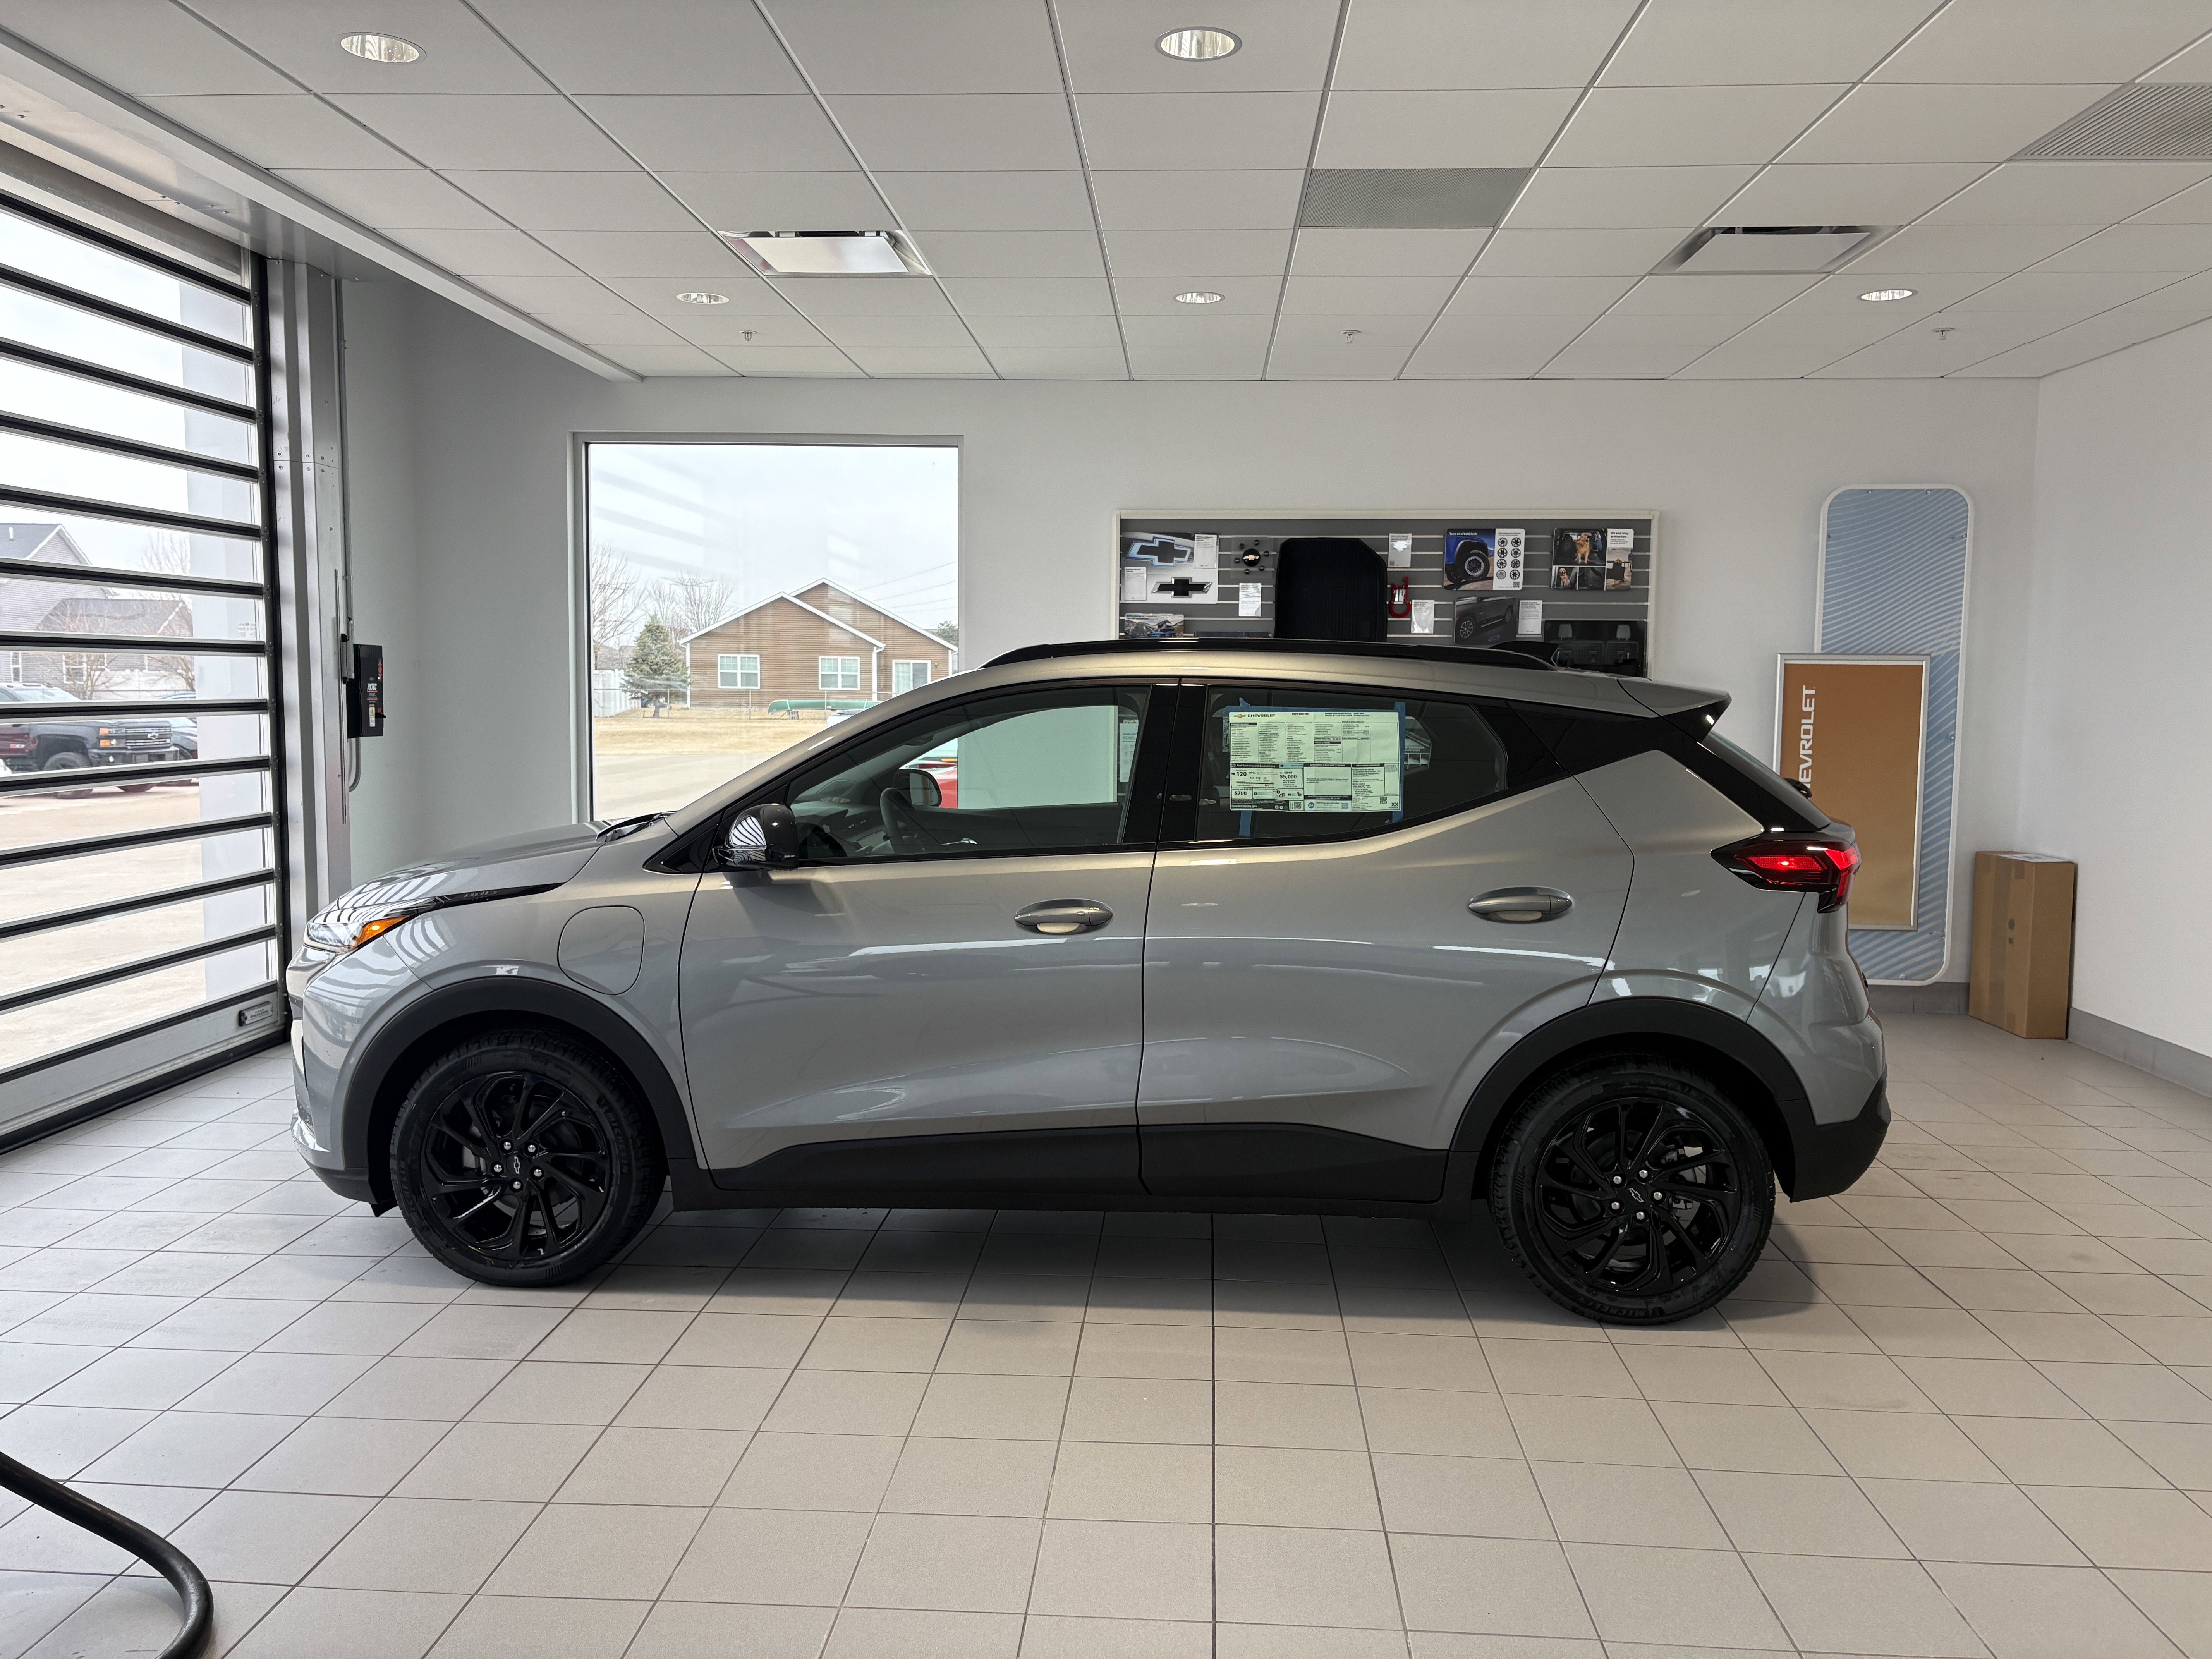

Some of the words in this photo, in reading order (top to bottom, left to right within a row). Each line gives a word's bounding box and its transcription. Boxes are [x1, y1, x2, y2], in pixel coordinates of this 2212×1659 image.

[1799, 685, 1815, 788] EVROLET
[606, 1111, 628, 1174] MICHELIN
[399, 1159, 417, 1211] ICHELIN
[1577, 1297, 1645, 1316] MICHELIN
